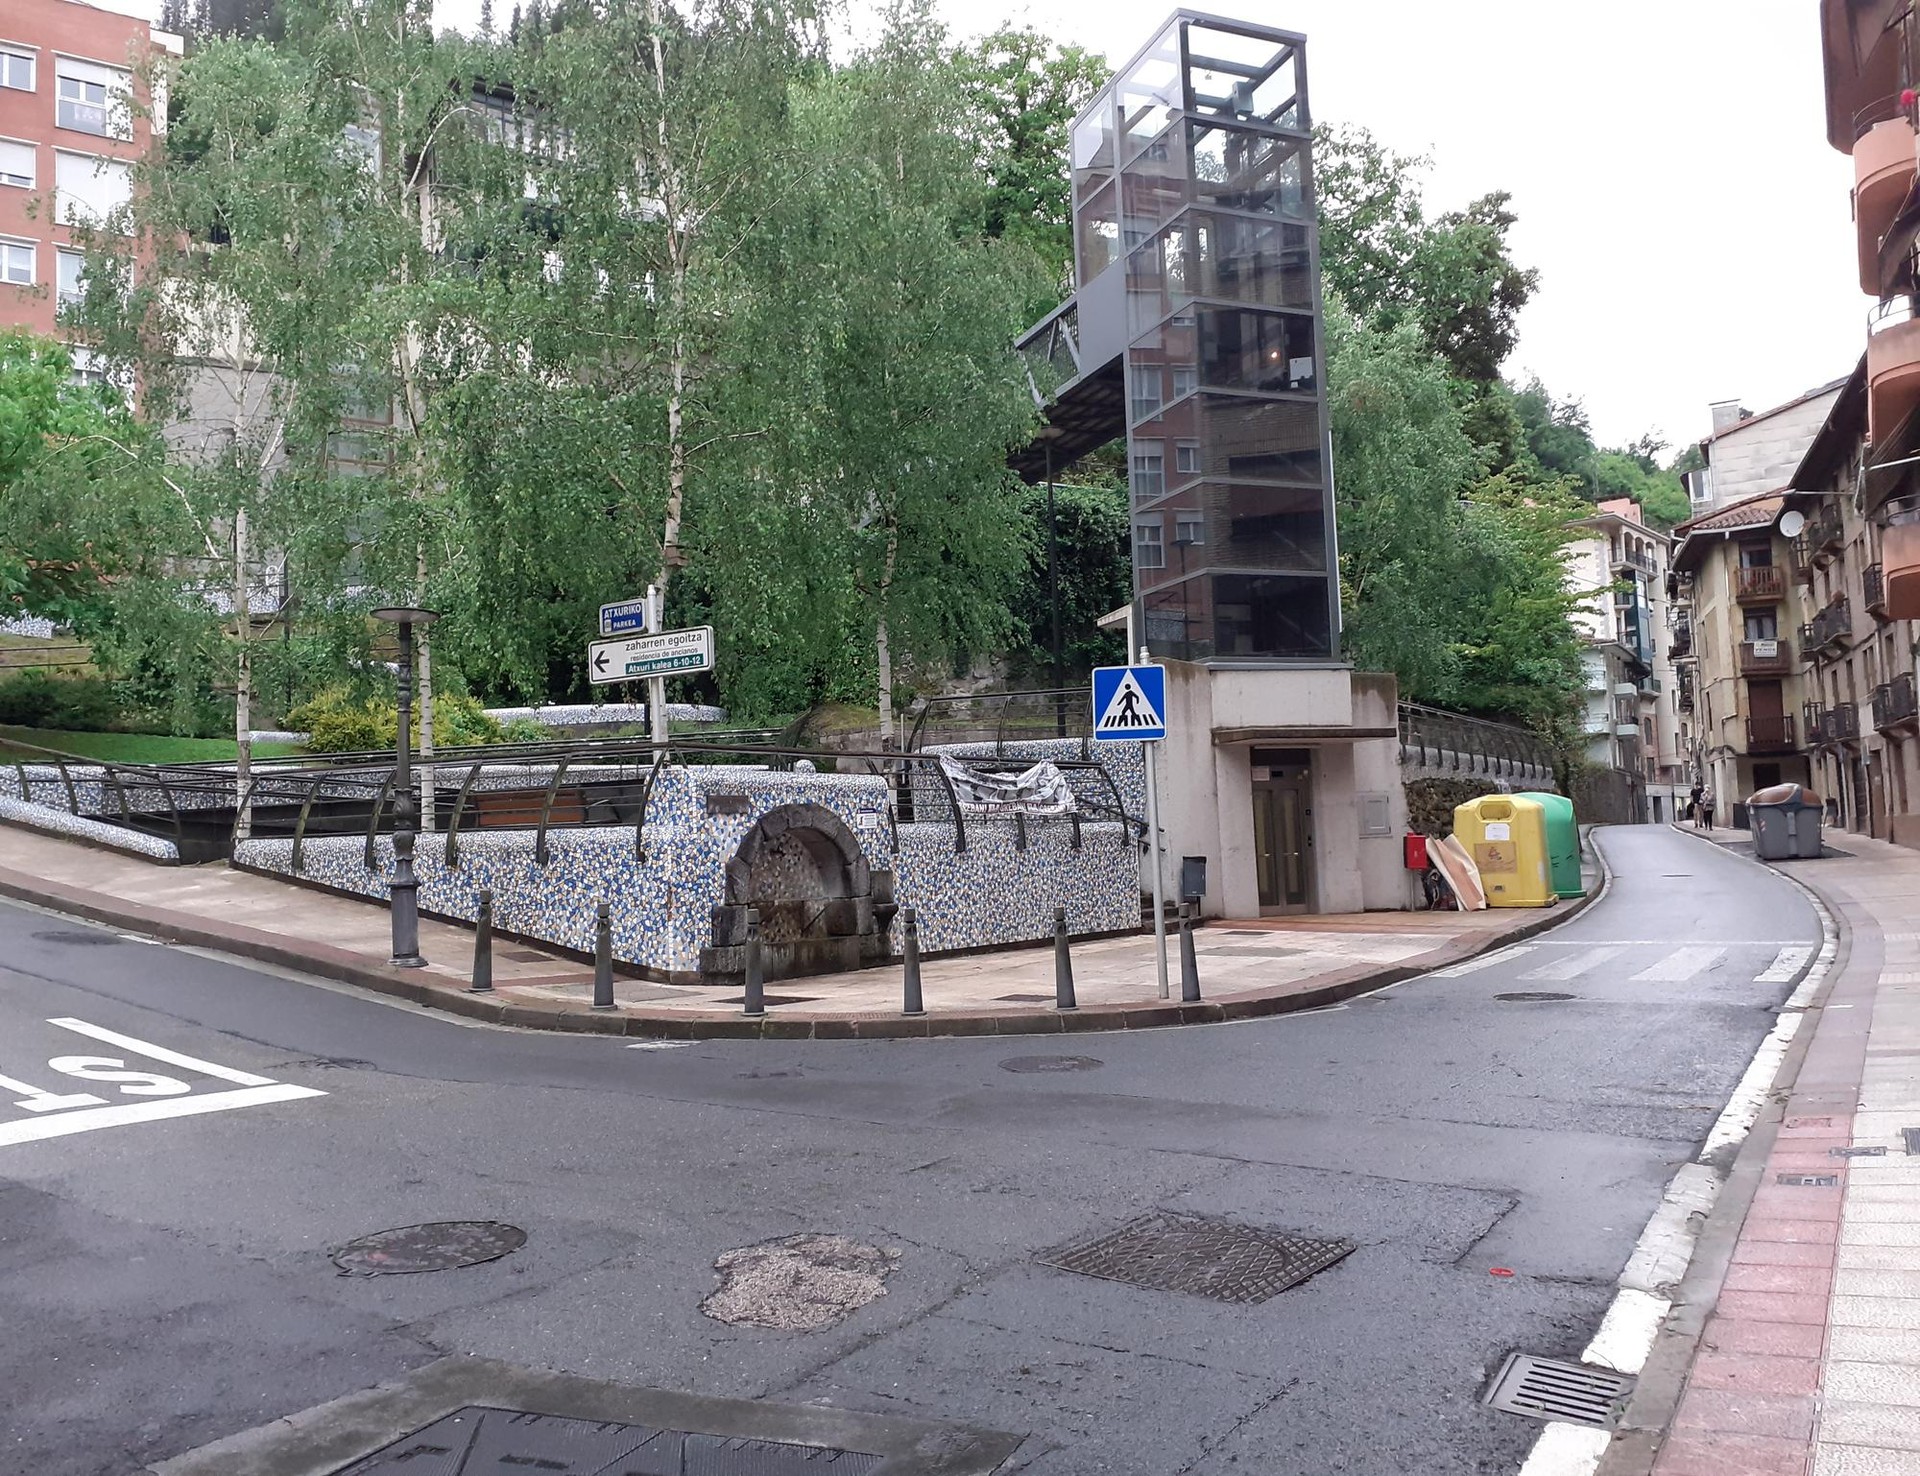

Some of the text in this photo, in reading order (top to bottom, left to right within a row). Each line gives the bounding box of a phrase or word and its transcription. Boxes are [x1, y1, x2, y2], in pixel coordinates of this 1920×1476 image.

[604, 604, 641, 619] ATXURIKO
[613, 619, 636, 629] PARKEA
[625, 633, 702, 651] zaharren egoitza
[630, 652, 660, 661] residencia
[671, 647, 698, 656] ancianos
[628, 656, 701, 673] Atxuri kalea 6-10-12
[0, 1056, 191, 1112] ST
